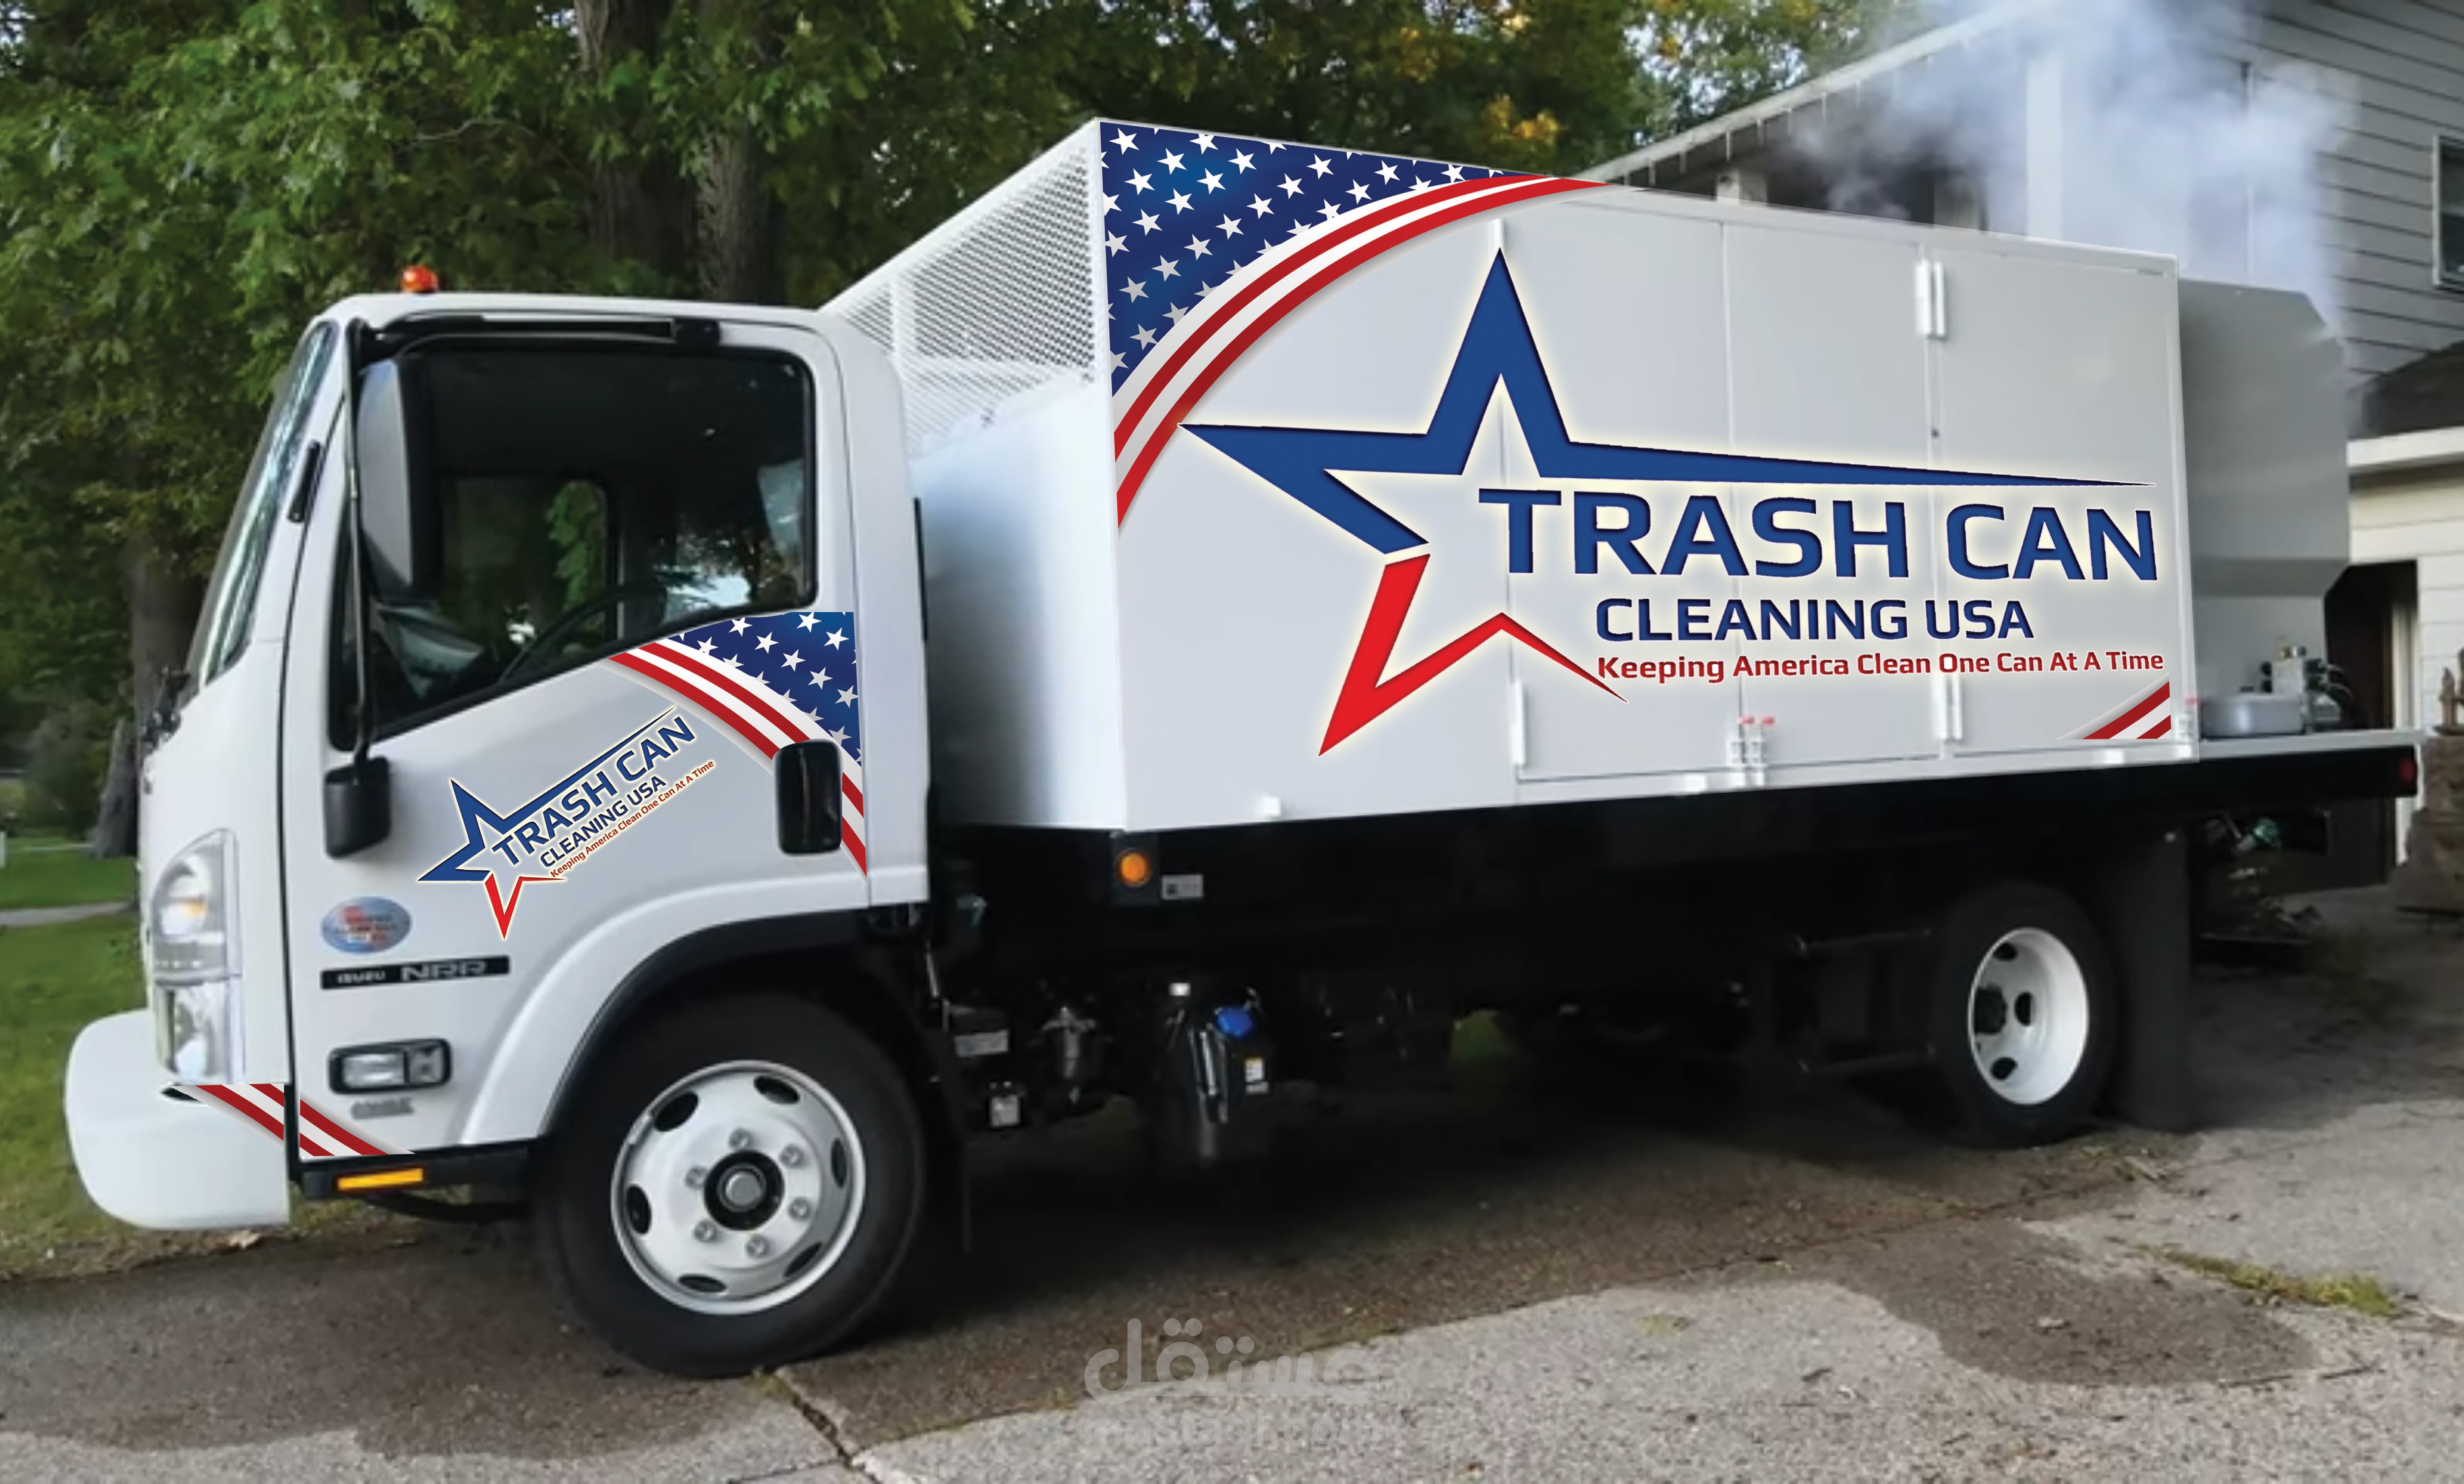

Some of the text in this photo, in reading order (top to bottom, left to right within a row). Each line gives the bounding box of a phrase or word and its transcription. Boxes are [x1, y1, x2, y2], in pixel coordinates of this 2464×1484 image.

[1479, 488, 2158, 580] TRASH CAN
[1596, 598, 2035, 642] CLEANING USA
[1598, 650, 2164, 684] Keeping America Clean One Can At A Time
[492, 716, 695, 865] TRASH CAN
[540, 776, 666, 867] CLEANING USA
[550, 760, 715, 878] Keeping America Clean One Can At A Time
